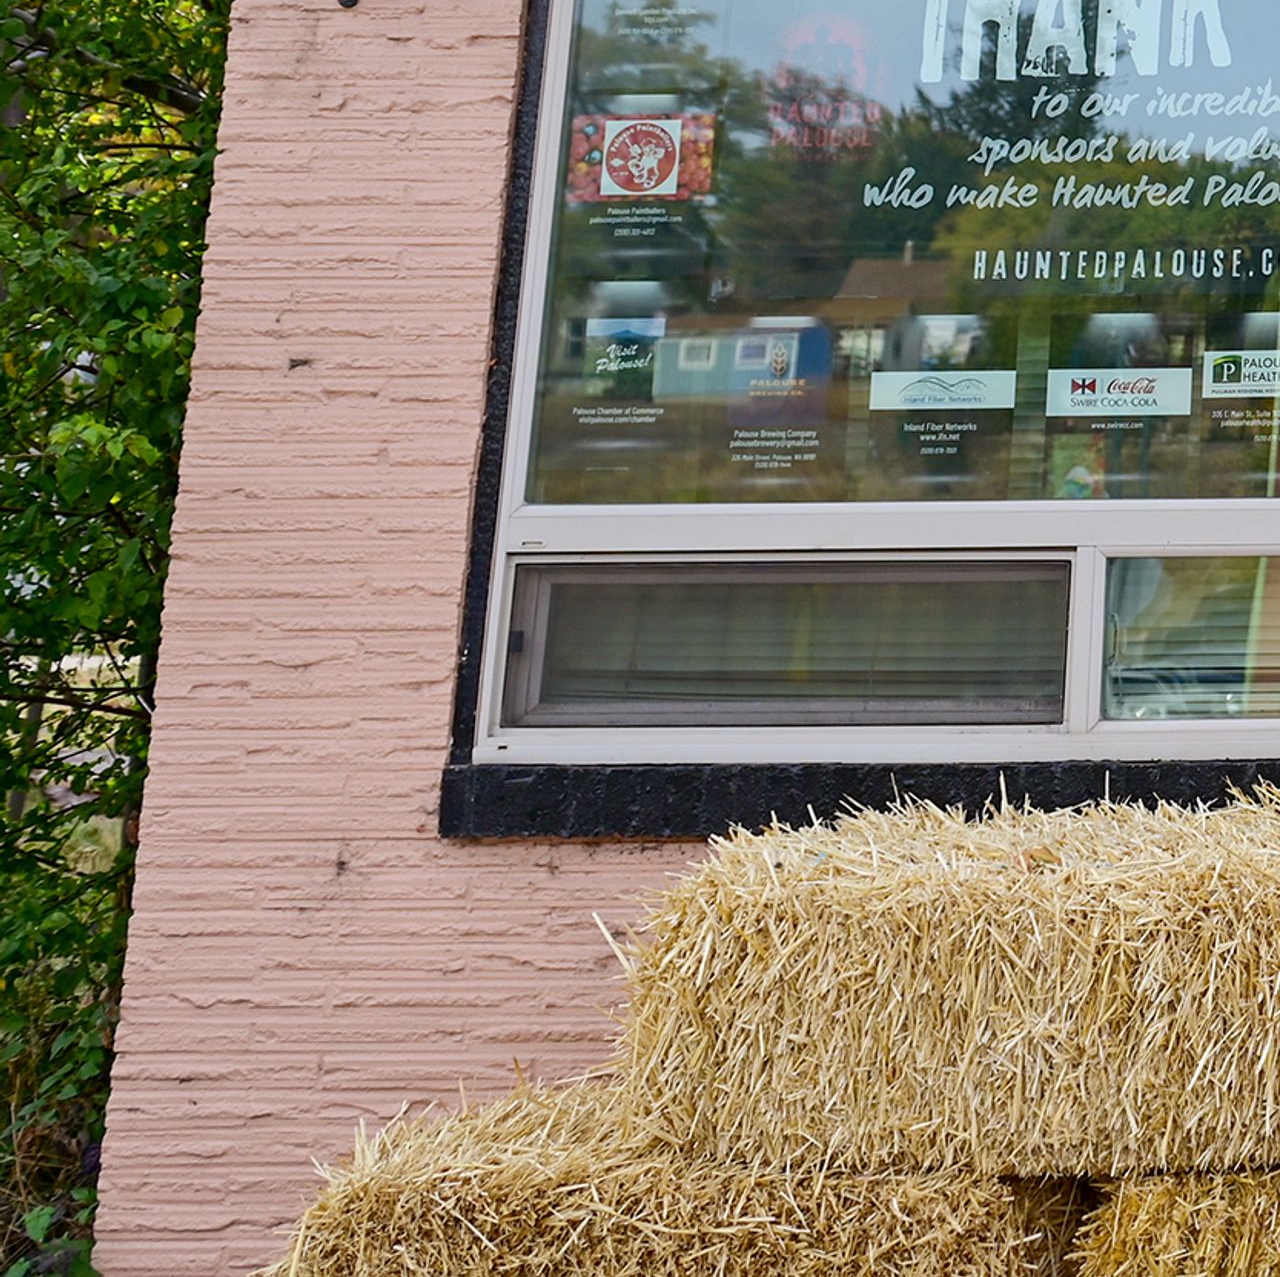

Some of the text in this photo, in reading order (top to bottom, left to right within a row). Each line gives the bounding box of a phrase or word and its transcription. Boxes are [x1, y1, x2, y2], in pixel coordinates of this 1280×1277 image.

[1032, 84, 1063, 119] to
[1080, 93, 1132, 118] our
[967, 132, 1116, 177] sponsors
[1127, 126, 1190, 163] and
[862, 166, 934, 210] who
[946, 174, 1038, 210] make
[1051, 169, 1190, 209] Haunted
[595, 353, 653, 374] Palouse!
[606, 343, 638, 358] Visit
